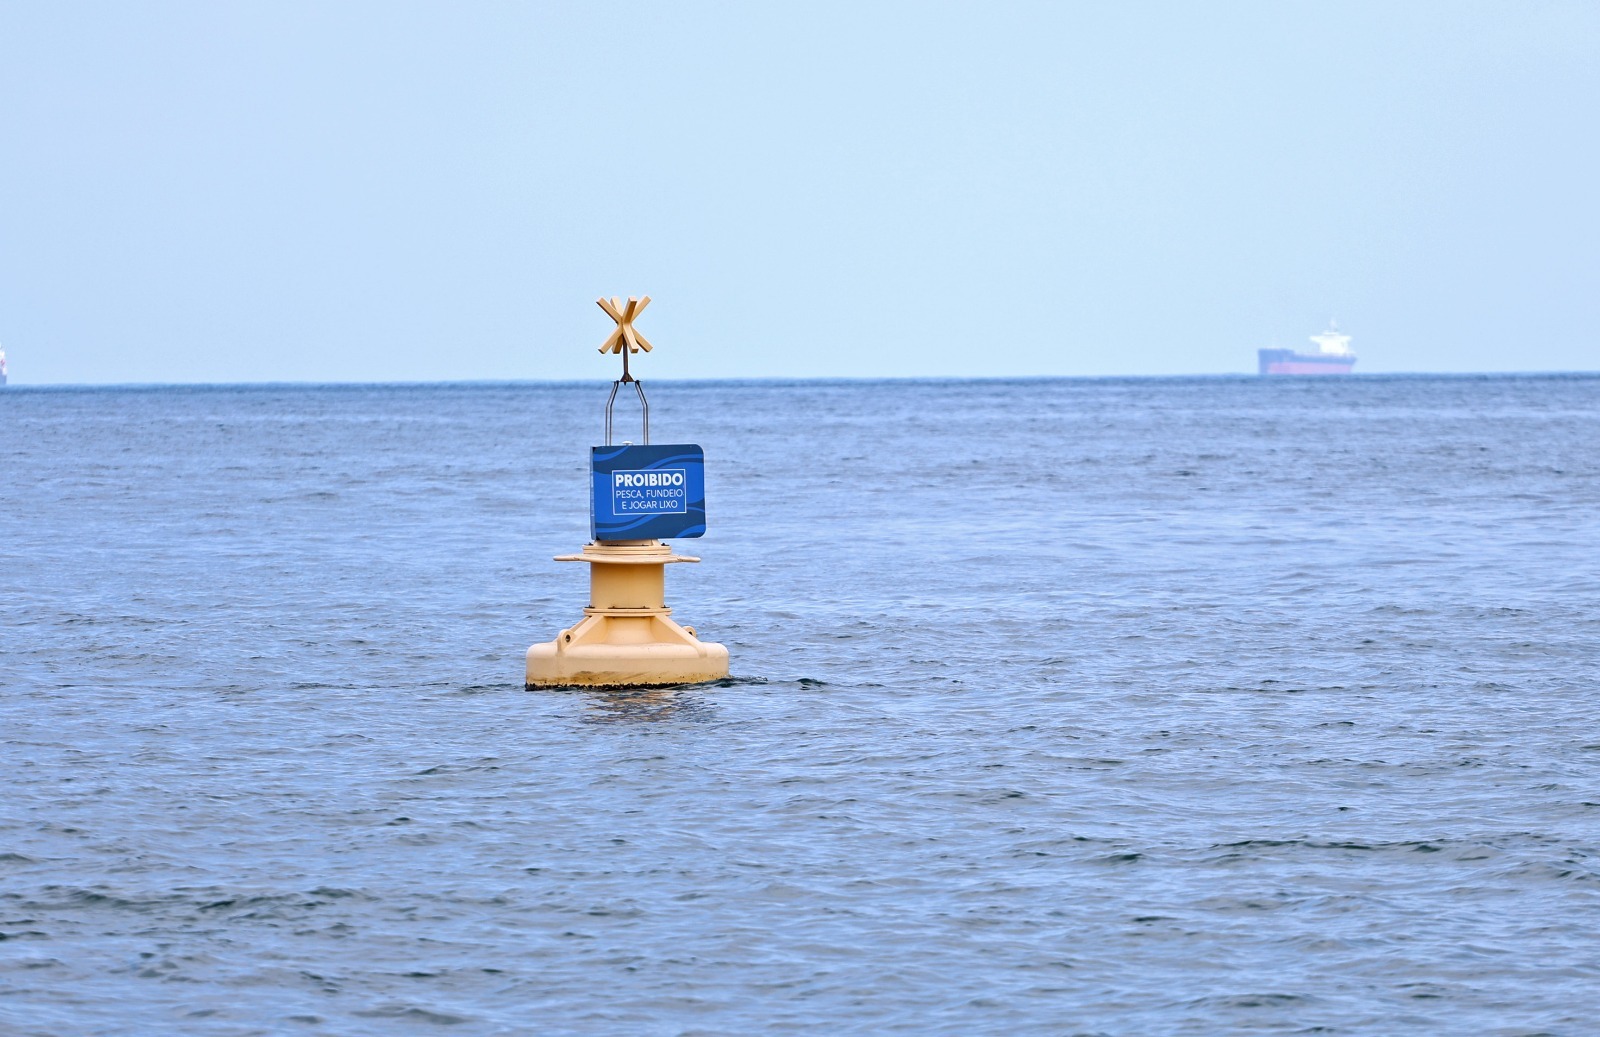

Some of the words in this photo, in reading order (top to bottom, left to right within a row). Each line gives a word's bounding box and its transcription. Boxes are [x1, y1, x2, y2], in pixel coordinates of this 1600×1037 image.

[615, 473, 683, 487] PROIBIDO
[616, 490, 644, 499] PESCA,
[646, 489, 683, 498] FUNDEIO
[622, 501, 627, 509] E
[629, 501, 657, 509] JOGAR
[660, 500, 678, 508] LIXO
